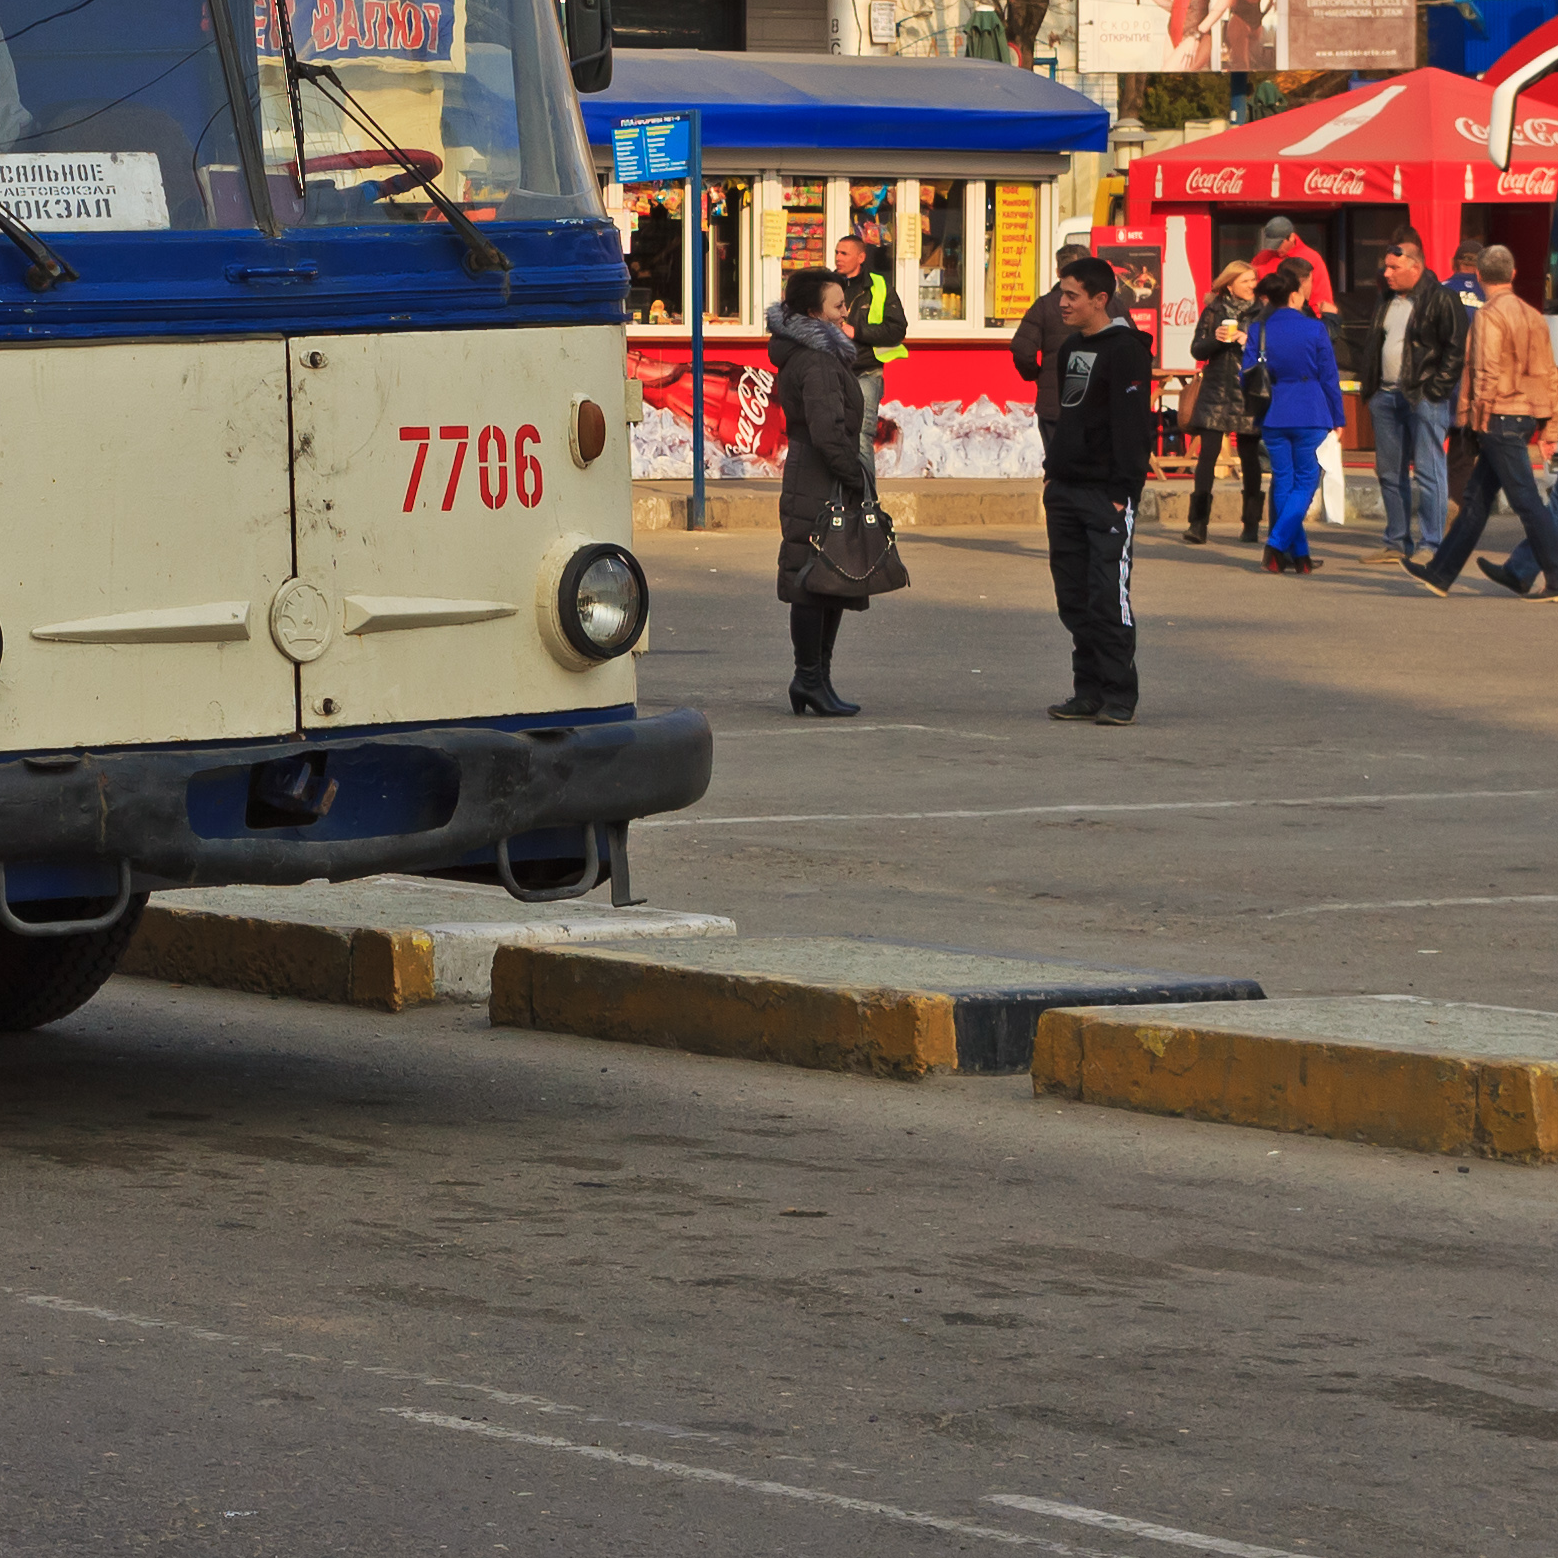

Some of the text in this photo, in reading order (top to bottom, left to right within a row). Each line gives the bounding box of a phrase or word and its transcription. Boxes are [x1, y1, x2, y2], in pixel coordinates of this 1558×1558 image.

[1100, 21, 1151, 31] СКОРО
[1100, 34, 1151, 42] ОТКРЫТИЕ
[1186, 167, 1246, 195] Coca-Cola
[1304, 167, 1366, 195] Coca-Cola
[1497, 167, 1557, 195] Coca-Cola
[399, 423, 544, 513] 7706
